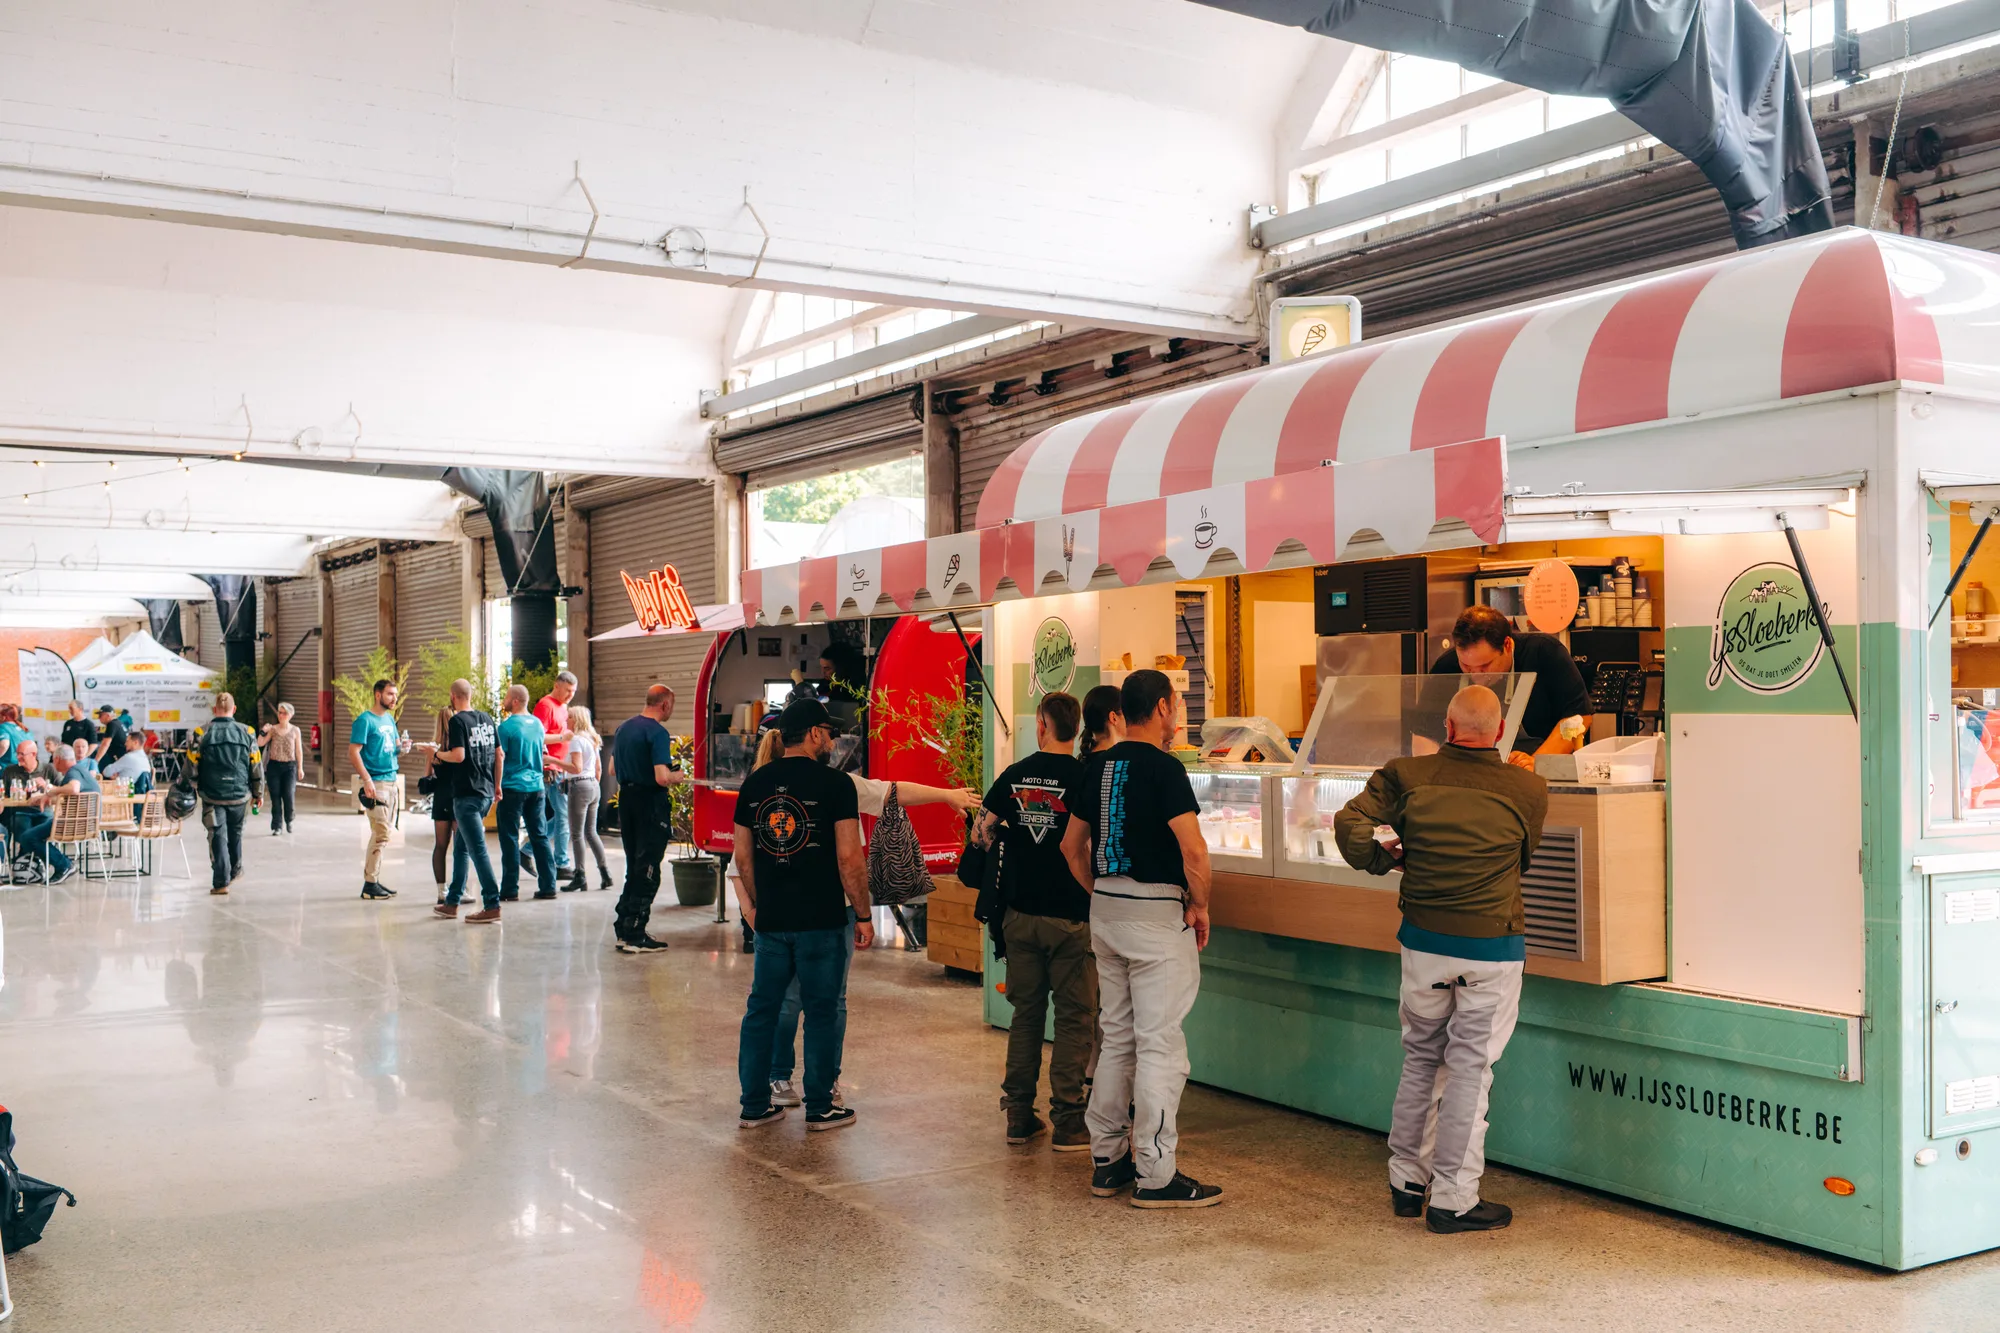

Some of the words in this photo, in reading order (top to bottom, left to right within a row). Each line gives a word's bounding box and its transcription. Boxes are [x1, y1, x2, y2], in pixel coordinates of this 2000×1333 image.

[1745, 664, 1757, 675] DAT
[1765, 670, 1779, 679] DOET
[1780, 655, 1803, 676] SMELTEN
[1021, 776, 1042, 785] MOTO
[1043, 778, 1059, 787] TOUR
[1019, 813, 1055, 825] TENERIFE
[1568, 1061, 1842, 1144] WWW.IJSSLOEBERKE.BE
